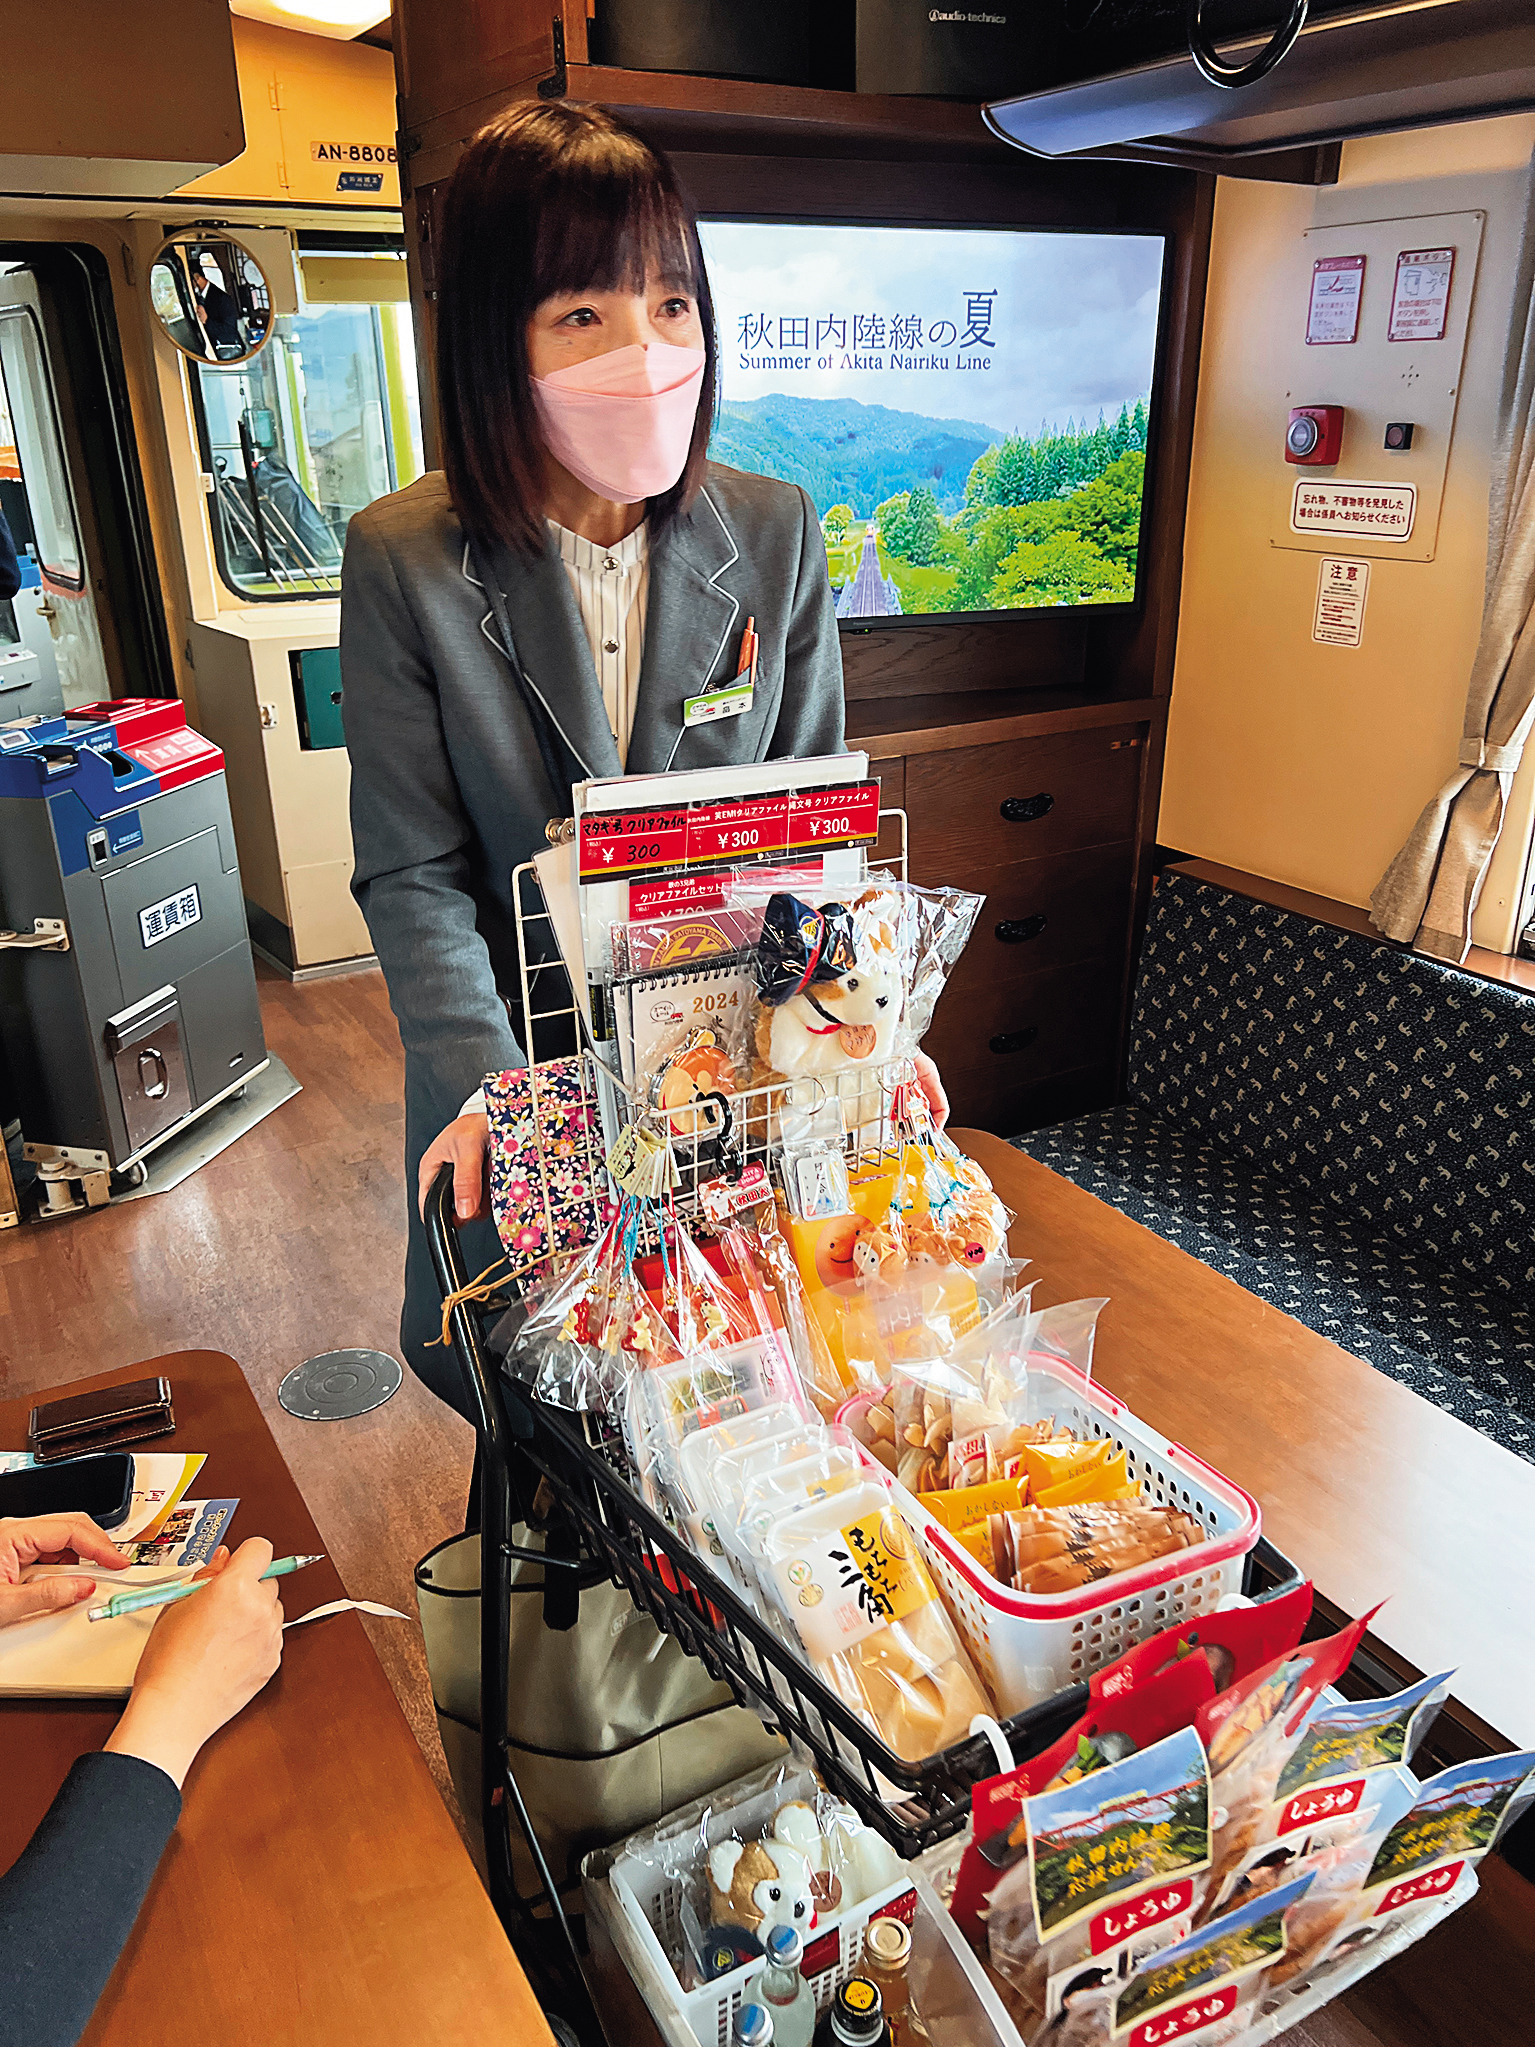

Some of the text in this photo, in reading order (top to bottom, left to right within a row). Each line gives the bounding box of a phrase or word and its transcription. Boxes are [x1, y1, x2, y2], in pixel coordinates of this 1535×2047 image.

[939, 10, 1006, 24] audio-technica
[317, 144, 398, 163] AN-8808
[737, 289, 998, 351] 秋田内陸線の夏
[739, 353, 991, 370] Summer of Akita Nairiku Line
[1330, 564, 1358, 581] 注意
[814, 792, 870, 807] クリアファイル
[714, 804, 788, 821] 笑EMIクリアファイル
[810, 817, 850, 837] ¥300
[717, 829, 759, 849] ¥300
[627, 843, 661, 863] 300
[640, 882, 724, 903] クリアファイルセット
[145, 893, 197, 940] 運賃箱
[673, 927, 706, 939] SATOYAMA
[693, 990, 739, 1014] 2024
[741, 1175, 755, 1185] DOG
[737, 1186, 770, 1206] 秋田犬
[828, 1550, 894, 1624] 三角
[1290, 1788, 1354, 1820] しょうゆ
[1390, 1871, 1451, 1904] しょうゆ
[1104, 1891, 1182, 1936] しょうゆ
[1143, 1998, 1225, 2043] しょうゆ
